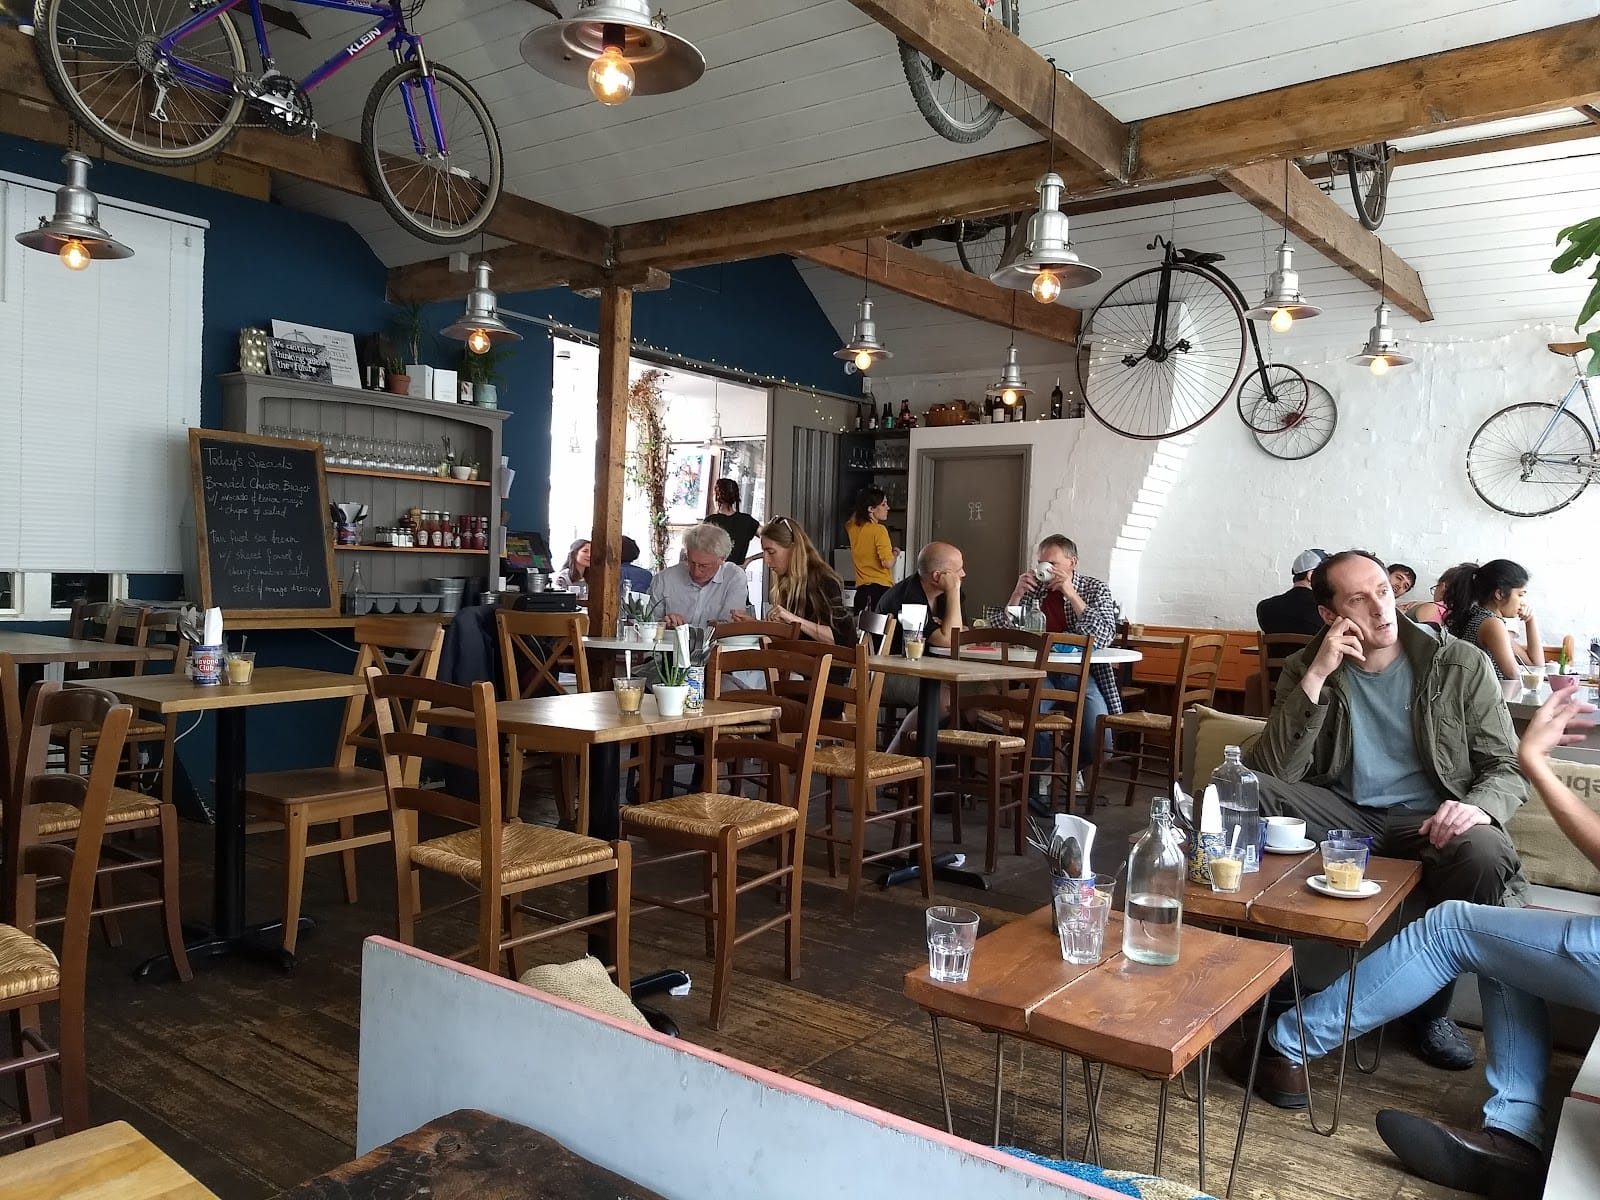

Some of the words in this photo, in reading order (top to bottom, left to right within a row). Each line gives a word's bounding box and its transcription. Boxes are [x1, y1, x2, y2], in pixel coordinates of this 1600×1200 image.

[346, 27, 382, 56] KLEIN
[272, 340, 284, 349] We
[275, 350, 306, 365] thinking
[276, 360, 290, 370] the
[203, 447, 244, 471] Today's
[248, 451, 293, 475] Specials
[281, 479, 311, 498] Burger
[221, 493, 248, 501] avocado
[282, 497, 304, 508] mayo
[225, 504, 249, 520] chips
[262, 505, 287, 518] salad
